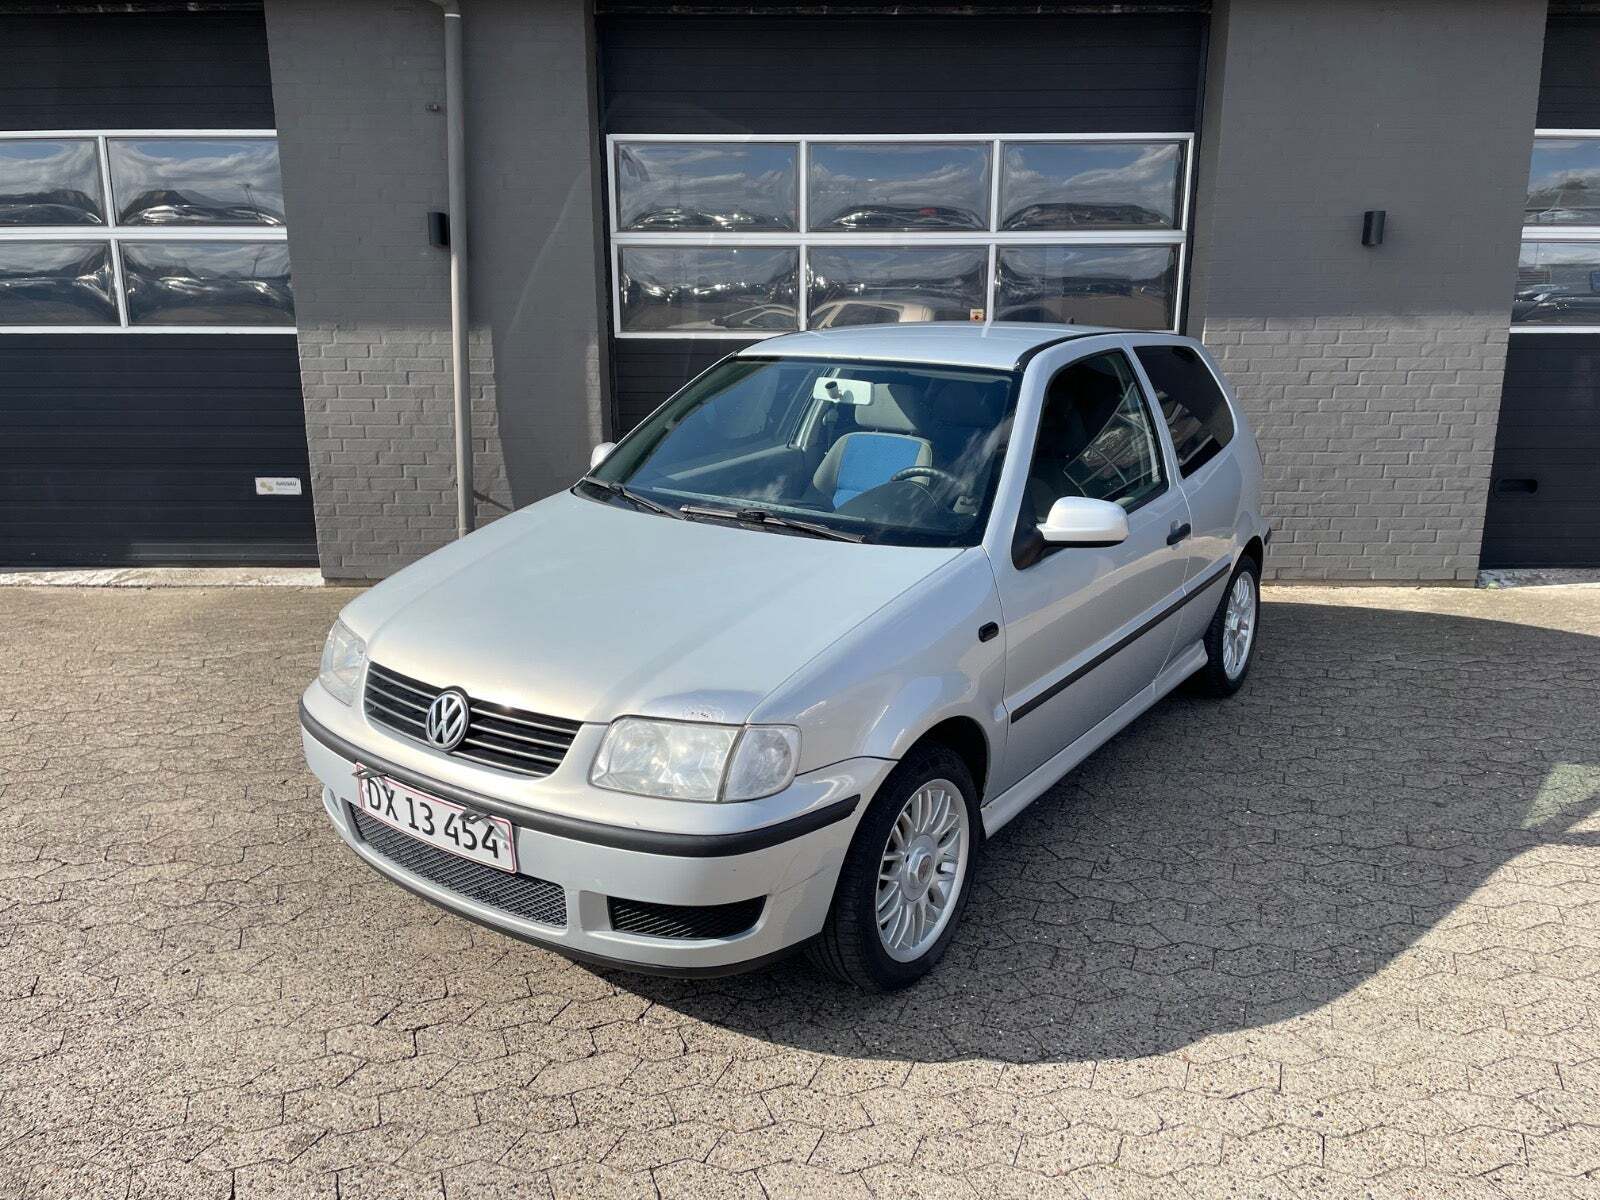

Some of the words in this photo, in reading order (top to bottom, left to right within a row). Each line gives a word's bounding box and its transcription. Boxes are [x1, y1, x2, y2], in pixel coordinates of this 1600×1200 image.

[366, 777, 398, 821] DX
[405, 796, 435, 836] 13
[443, 812, 499, 859] 454
